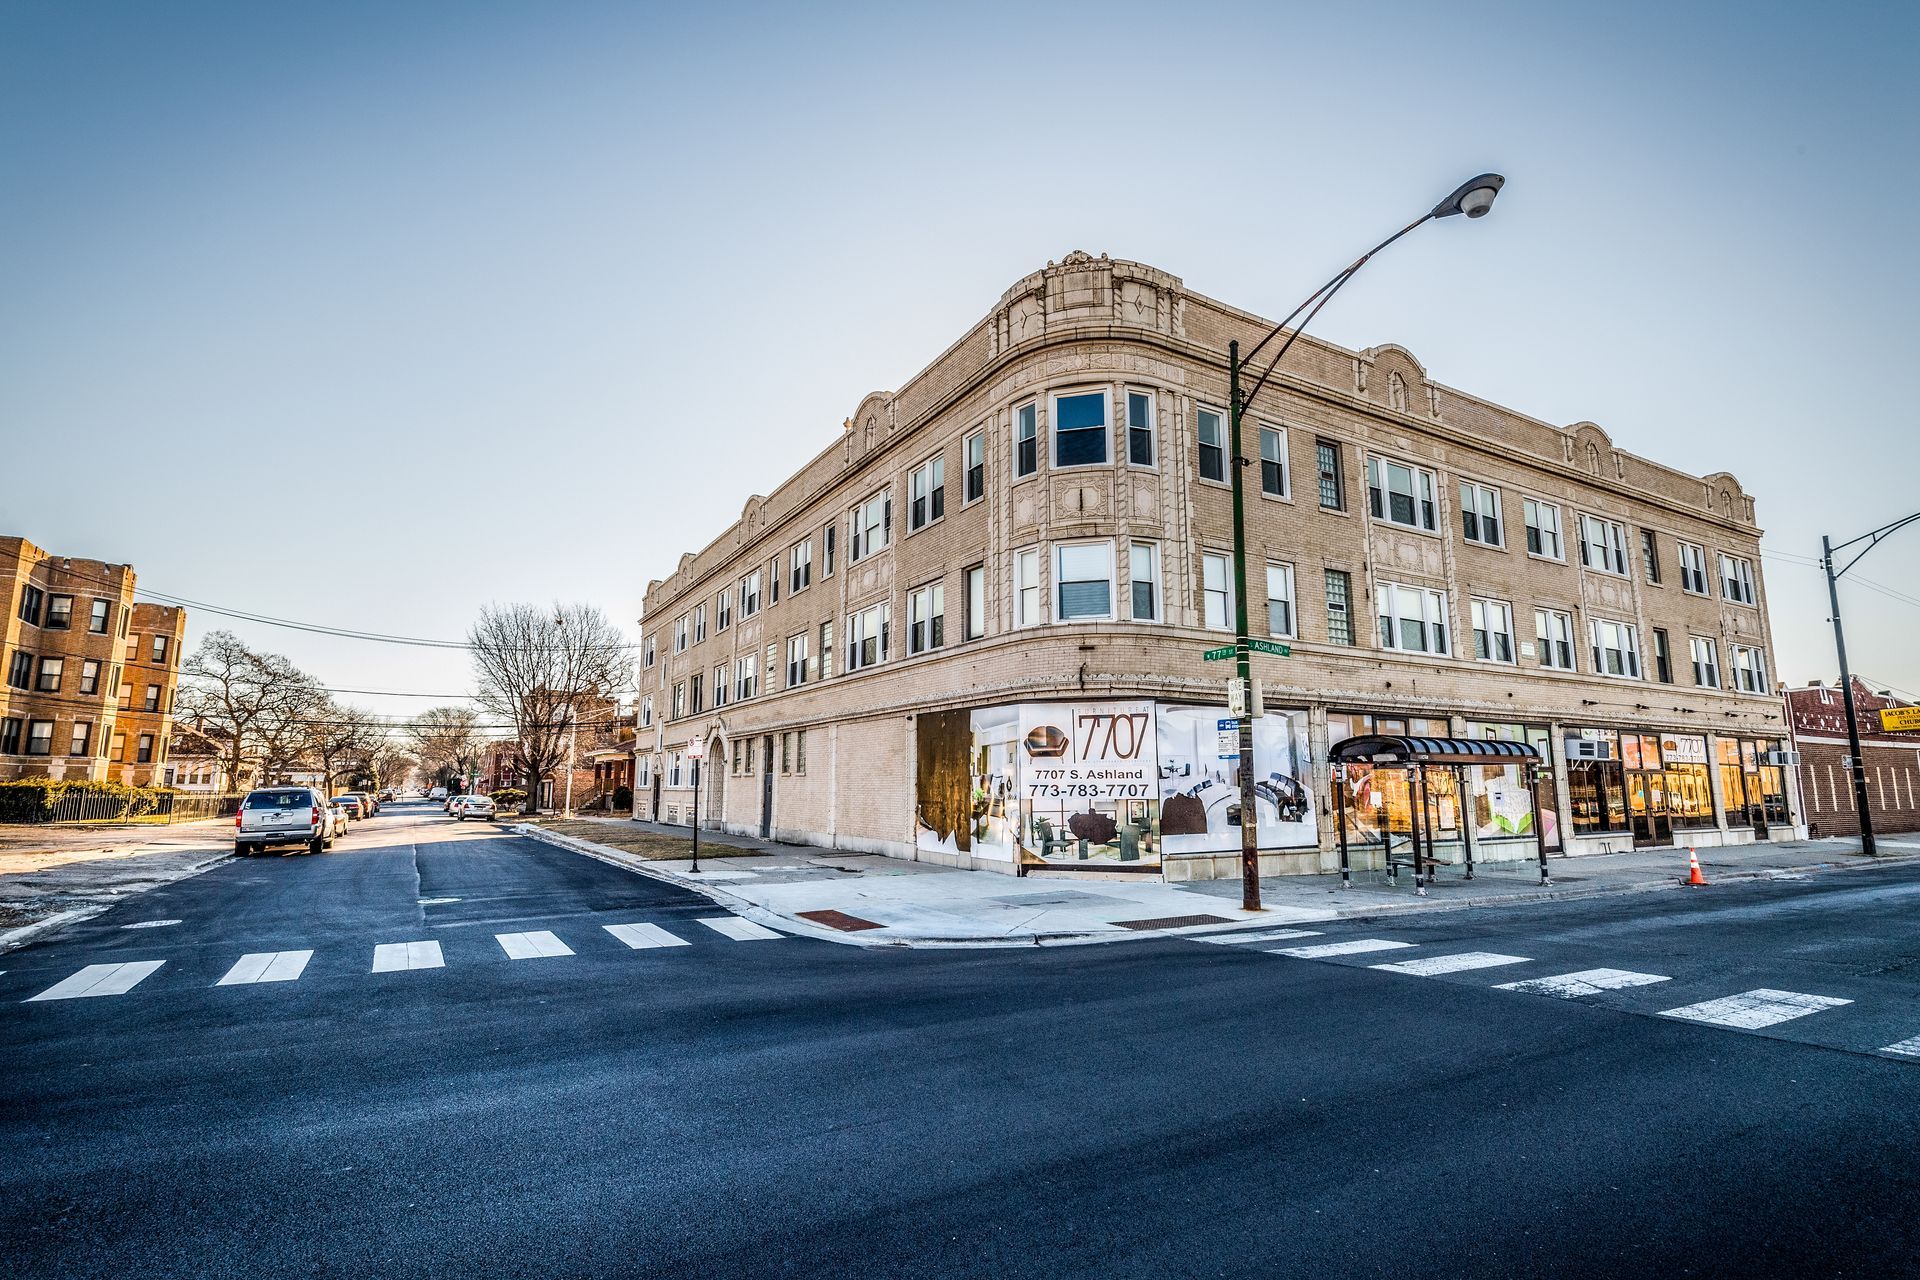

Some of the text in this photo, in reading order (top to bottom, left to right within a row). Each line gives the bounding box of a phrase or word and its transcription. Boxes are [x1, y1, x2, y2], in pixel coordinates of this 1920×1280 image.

[1254, 641, 1283, 655] ASHLAND
[1079, 713, 1149, 760] 7707
[1681, 738, 1703, 754] 7707
[1035, 769, 1143, 780] 7707 S. Ashland
[1029, 784, 1149, 797] 773-783-7707
